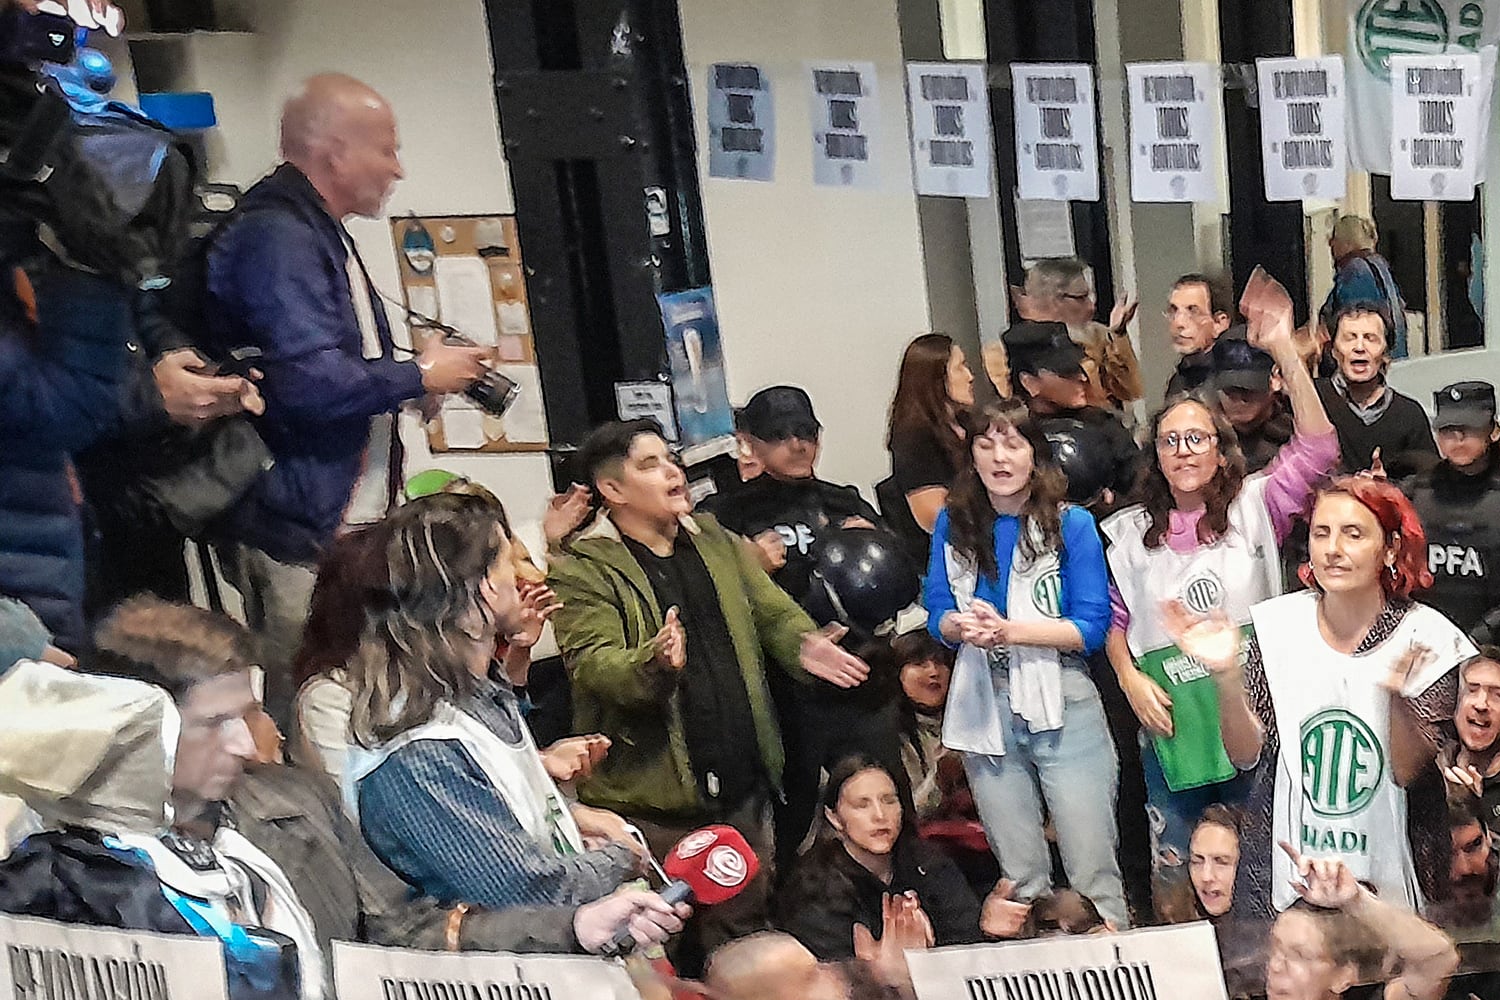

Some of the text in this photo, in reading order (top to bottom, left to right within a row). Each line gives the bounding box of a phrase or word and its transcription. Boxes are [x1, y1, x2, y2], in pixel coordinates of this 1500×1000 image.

[774, 525, 816, 555] PF
[1428, 543, 1485, 577] PFA
[1301, 719, 1373, 808] ATE
[1302, 824, 1369, 856] NADI
